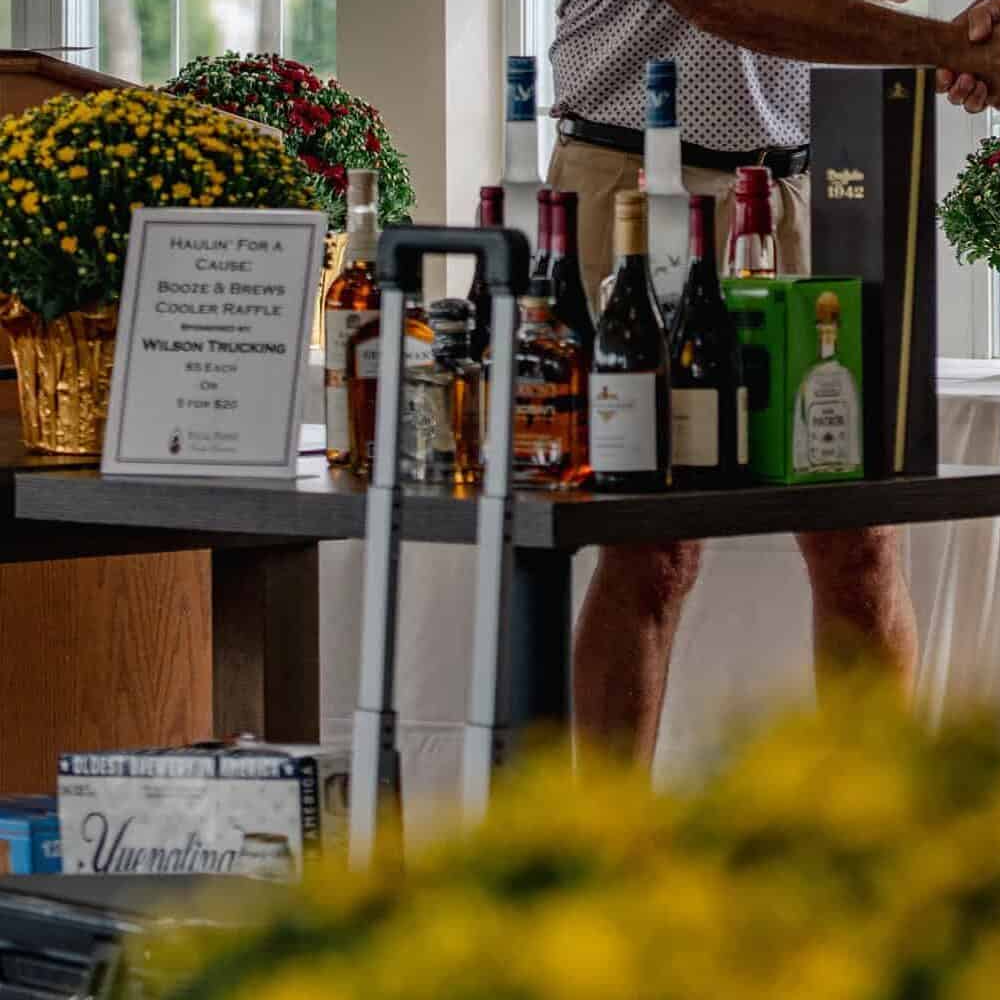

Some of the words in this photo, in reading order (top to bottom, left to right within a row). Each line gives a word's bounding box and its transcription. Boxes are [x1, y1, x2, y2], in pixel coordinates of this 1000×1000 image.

[238, 238, 269, 251] FOR
[272, 240, 284, 252] A
[158, 281, 210, 294] BOOZE
[230, 282, 286, 296] BREWS
[155, 302, 218, 314] COOLER
[223, 303, 282, 317] RAFFLE
[142, 338, 203, 353] WILSON
[208, 340, 286, 355] TRUCKING
